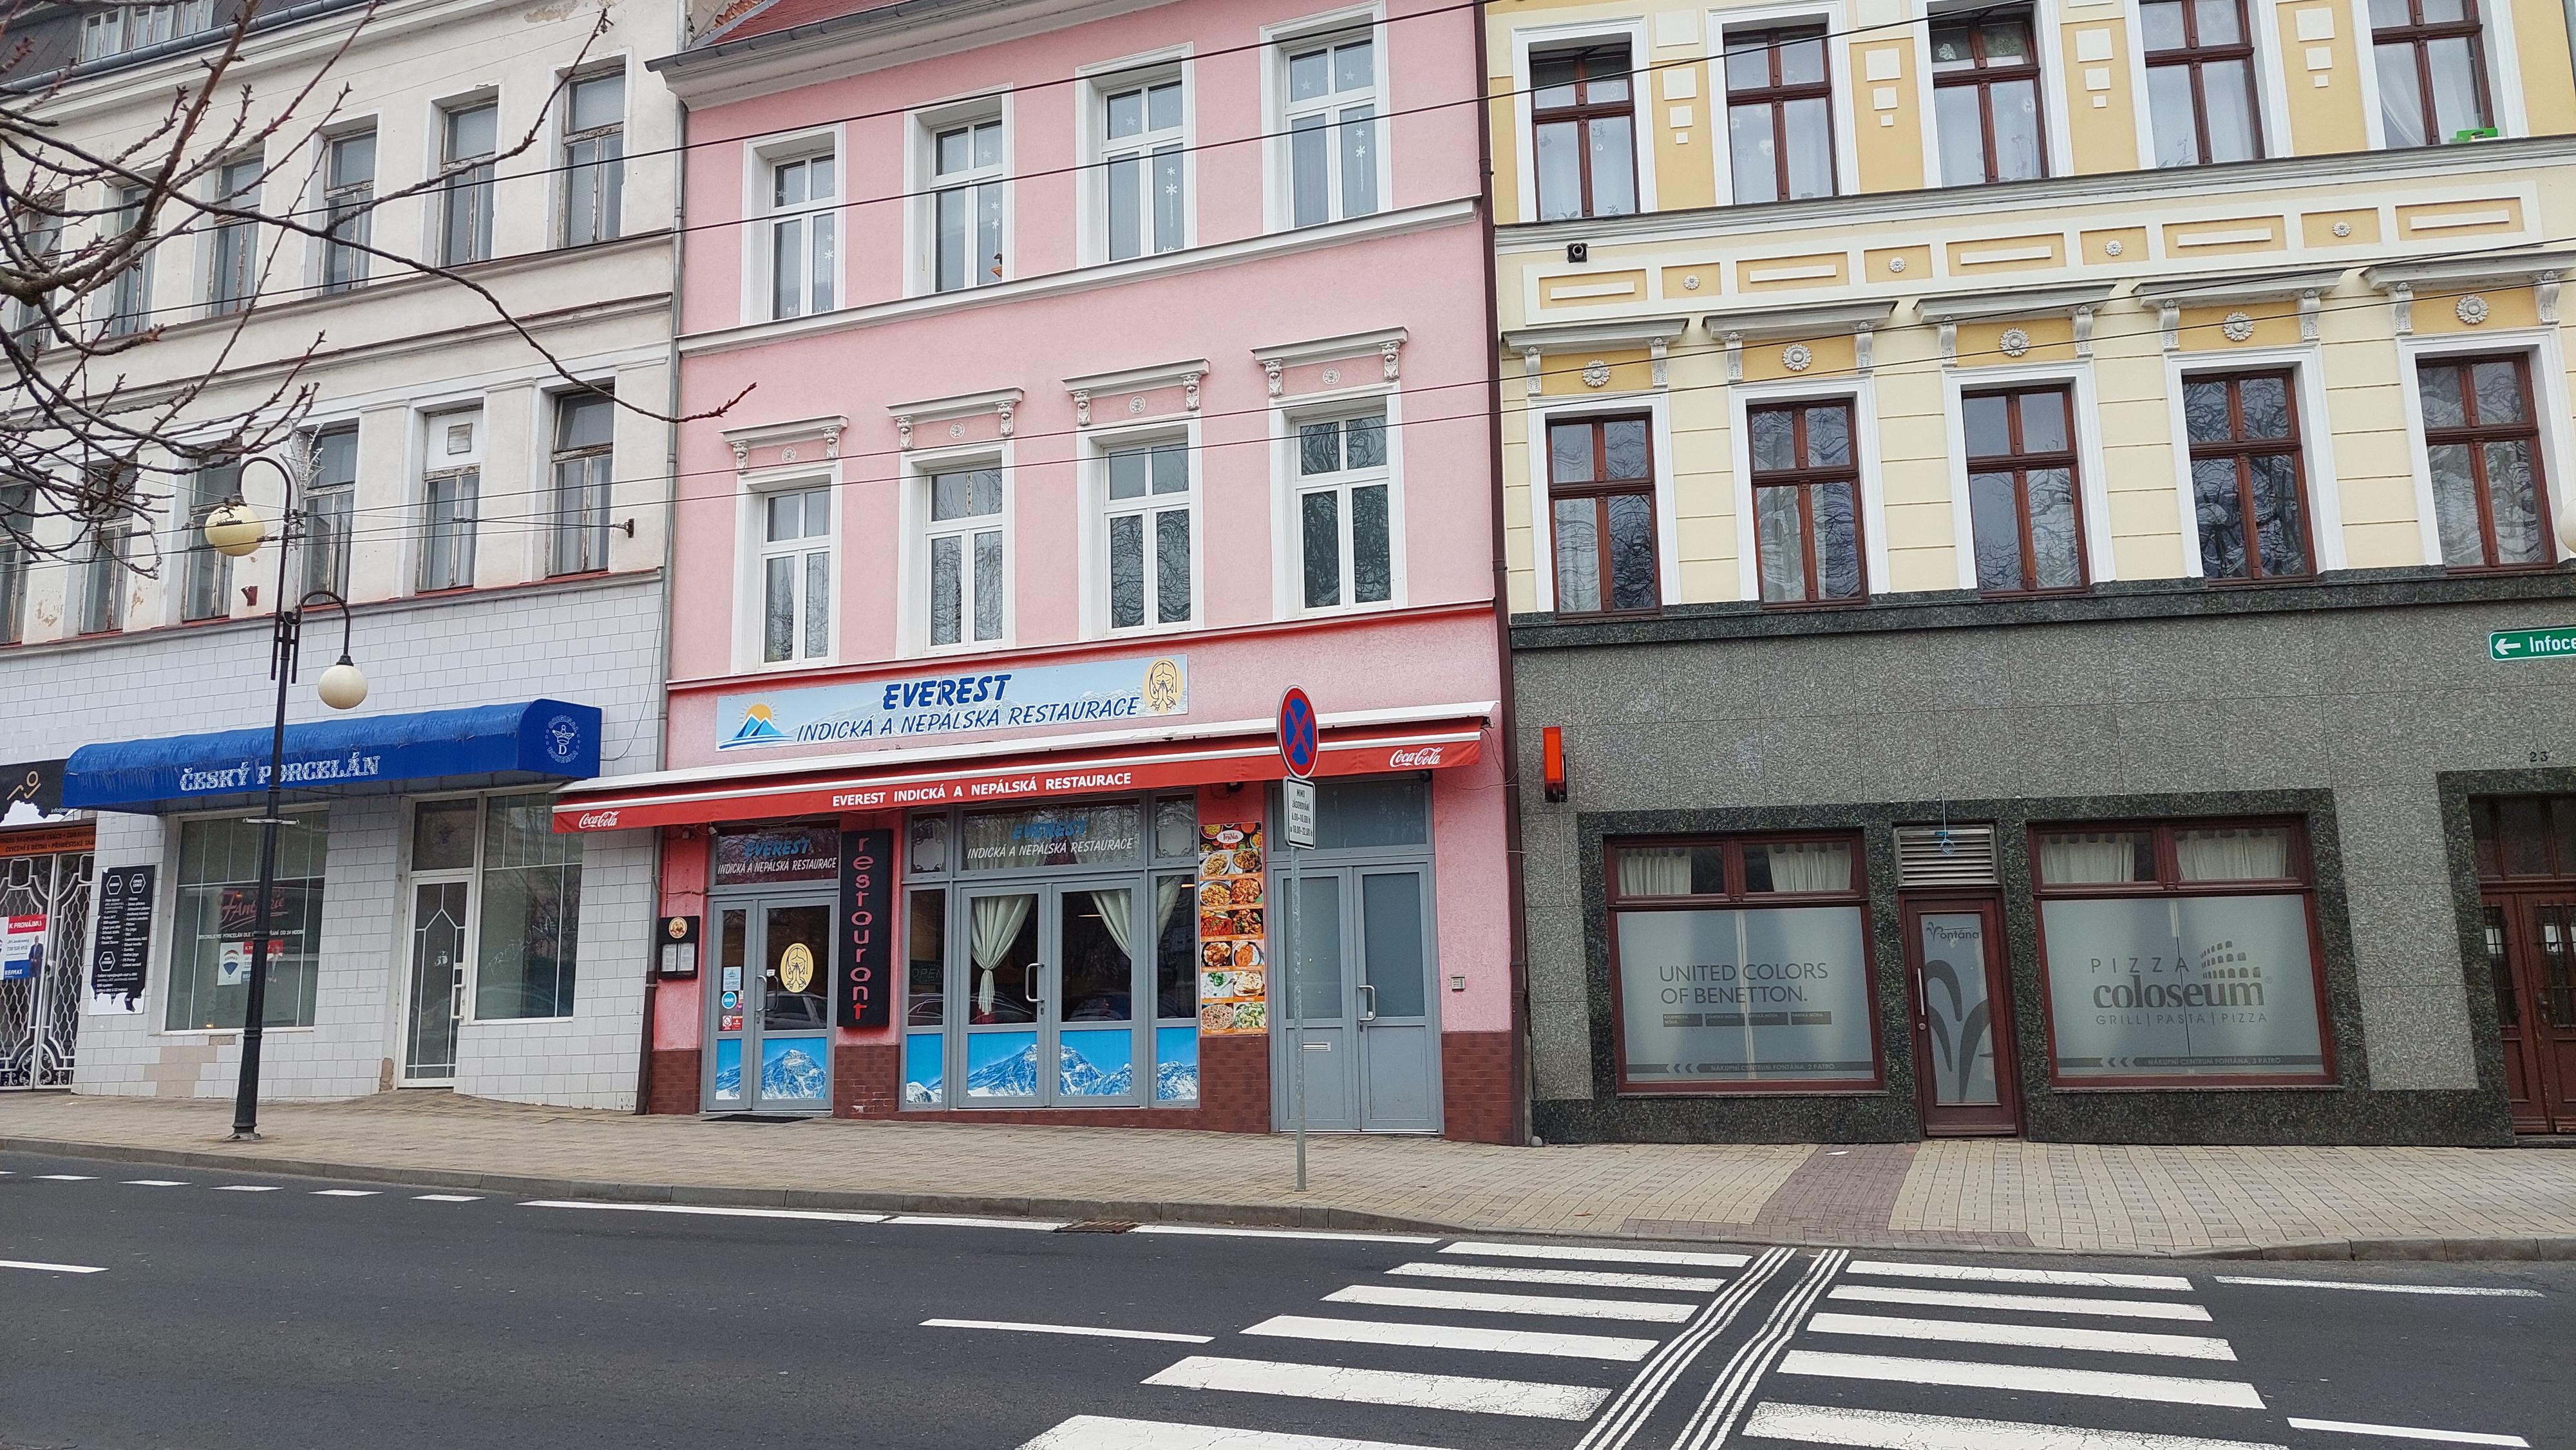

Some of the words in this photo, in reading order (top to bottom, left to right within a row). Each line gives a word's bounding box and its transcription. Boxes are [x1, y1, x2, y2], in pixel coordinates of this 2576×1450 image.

[882, 673, 1012, 710] EVEREST
[796, 715, 873, 742] INDICKÁ
[880, 718, 893, 735] A
[900, 706, 999, 735] NEPÁLSKÁ
[1007, 697, 1140, 726] RESTAURACE
[558, 744, 567, 755] D
[2530, 751, 2548, 762] 23
[180, 761, 251, 791] ČESKÝ
[833, 793, 886, 807] EVEREST
[894, 783, 945, 802] INDICKÁ
[953, 786, 963, 797] A
[971, 776, 1037, 796] NEPÁLSKÁ
[1045, 773, 1132, 790] RESTAURACE
[1296, 788, 1305, 798] MIMO
[1012, 819, 1088, 840] EVEREST
[744, 838, 811, 857] EVEREST
[967, 844, 1007, 859] INDICKÁ
[1009, 845, 1016, 856] A
[1018, 840, 1066, 856] NEPÁLSKÁ
[1070, 838, 1133, 852] RESTAURACE
[717, 860, 746, 875] INDICKÁ
[746, 862, 753, 873] A
[754, 858, 790, 872] NEPÁLSKÁ
[791, 857, 837, 870] RESTAURACE
[14, 919, 43, 929] PRONÁJMU
[850, 837, 874, 1019] restaurant
[1660, 965, 1736, 982] UNITED
[1743, 963, 1828, 980] COLORS
[2091, 957, 2190, 973] PIZZA
[1661, 988, 1689, 1004] OF
[2094, 975, 2264, 1008] coloseum
[2096, 1015, 2143, 1025] GRILL
[2157, 1013, 2205, 1024] PASTA
[2222, 1013, 2267, 1022] PIZZA
